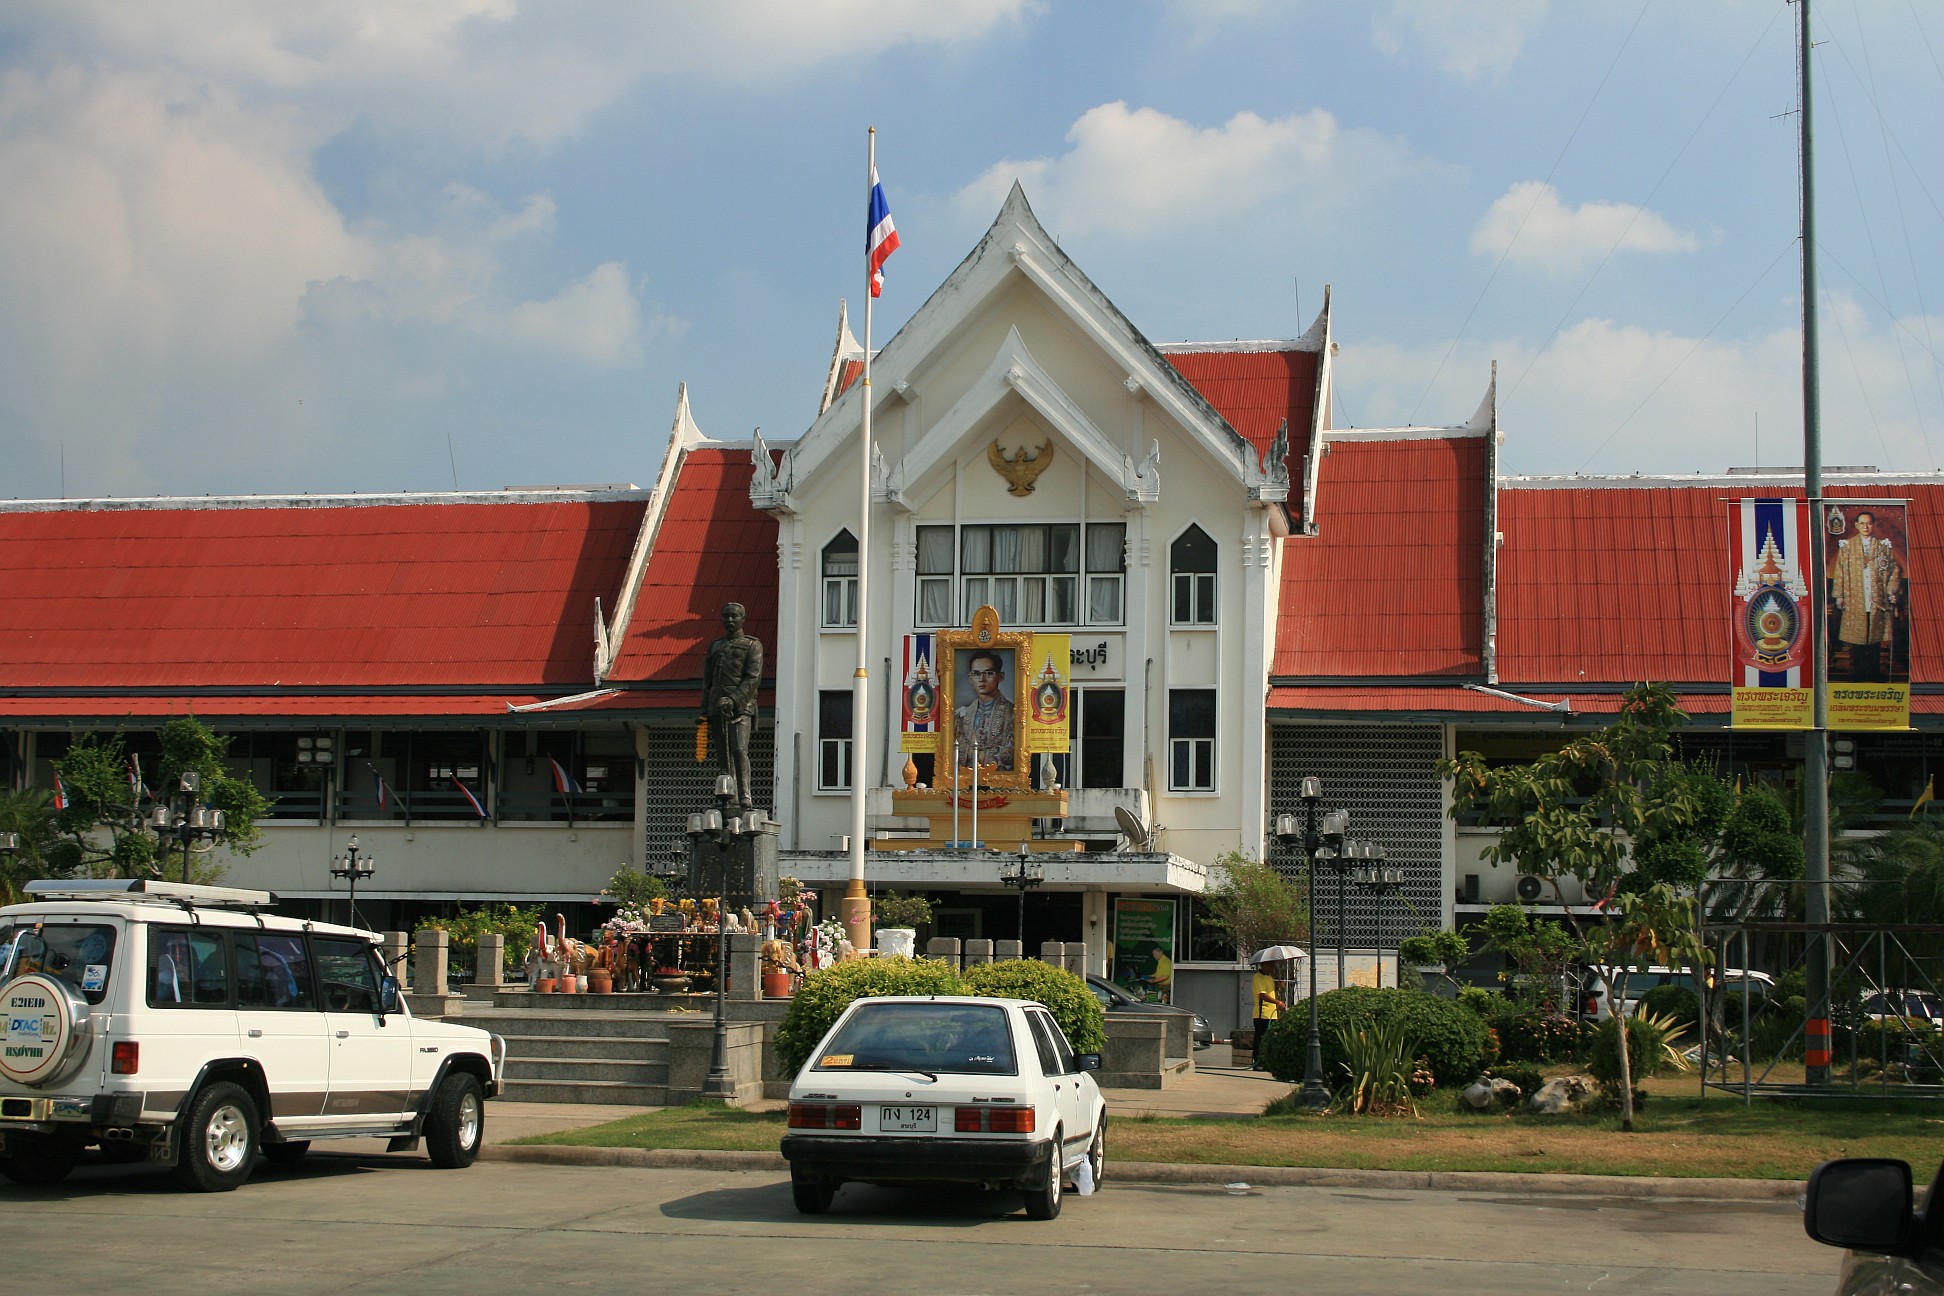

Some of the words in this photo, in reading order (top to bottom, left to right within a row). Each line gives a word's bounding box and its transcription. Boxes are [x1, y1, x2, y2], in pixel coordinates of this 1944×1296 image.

[1736, 688, 1809, 705] ทรงพระเจริญ
[1832, 687, 1905, 704] ทรงพระเจริญ
[11, 1019, 40, 1031] DTAC
[883, 1107, 901, 1121] กง
[910, 1107, 931, 1121] 124
[900, 1122, 917, 1131] สระบุรี
